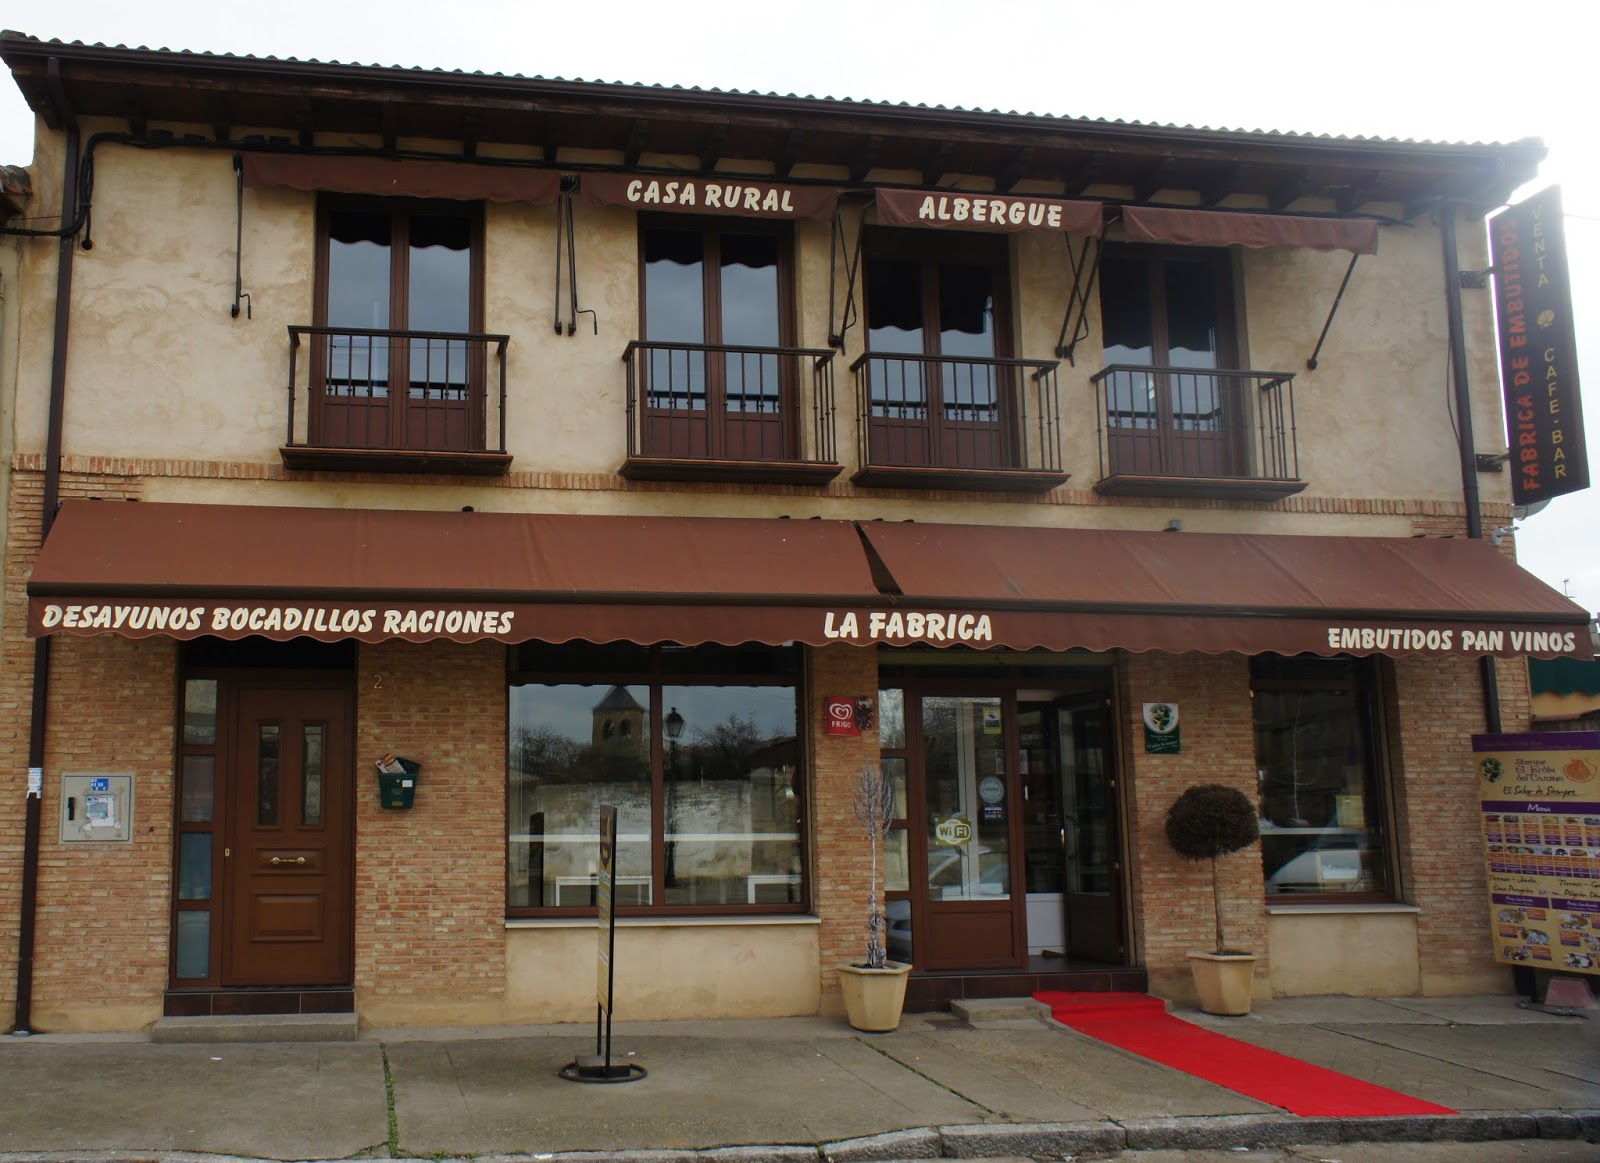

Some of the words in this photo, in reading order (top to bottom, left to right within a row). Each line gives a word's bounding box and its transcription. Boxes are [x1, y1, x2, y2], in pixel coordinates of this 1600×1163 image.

[627, 180, 695, 205] CASA
[705, 184, 794, 212] RURAL
[918, 196, 1063, 227] ALBERGUE
[1532, 205, 1549, 288] VENTA
[1500, 219, 1529, 348] EMBUTIDOS
[1512, 356, 1531, 386] DE
[1516, 394, 1541, 490] FABRICA
[42, 604, 205, 631] DESAYUNOS
[212, 606, 377, 634] BOCADILLOS
[383, 609, 515, 635] RACIONES
[824, 611, 859, 638] LA
[869, 612, 992, 641] FABRICA
[1328, 628, 1453, 651] EMBUTIDOS
[1461, 630, 1503, 651] PAN
[1510, 631, 1576, 652] VINOS
[373, 674, 383, 689] 2
[1503, 786, 1512, 794] El
[1536, 785, 1543, 794] de
